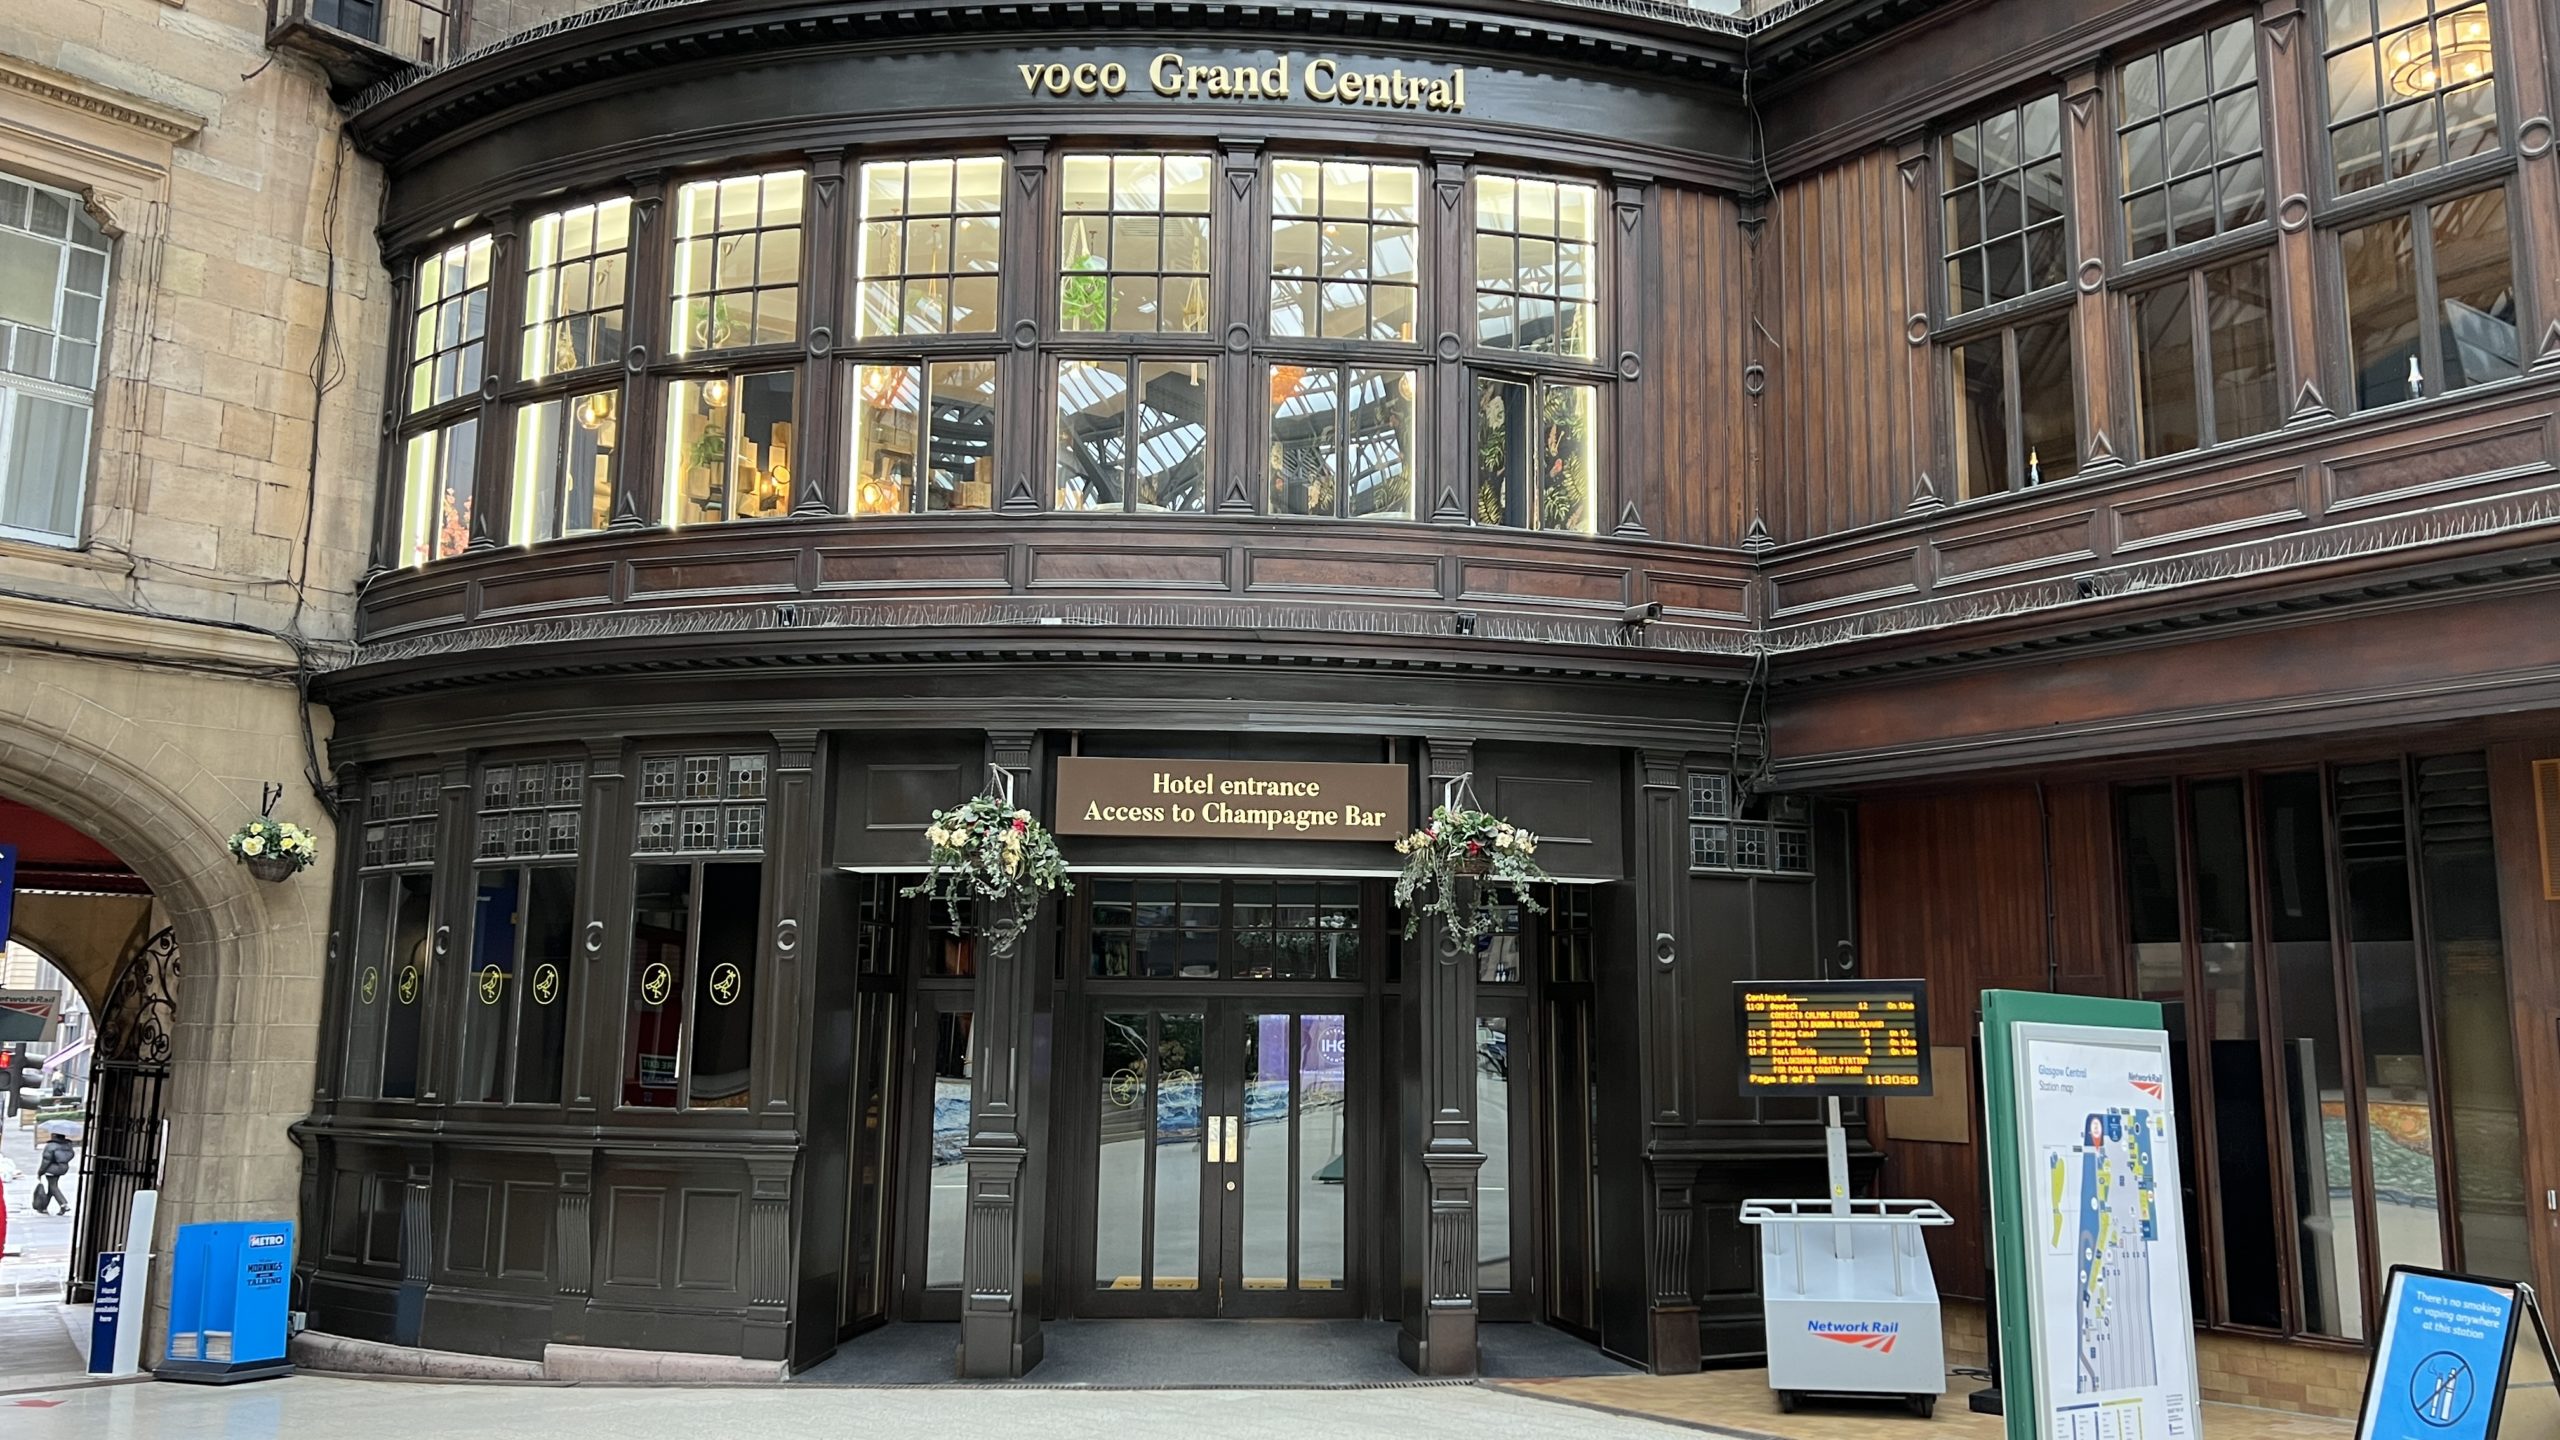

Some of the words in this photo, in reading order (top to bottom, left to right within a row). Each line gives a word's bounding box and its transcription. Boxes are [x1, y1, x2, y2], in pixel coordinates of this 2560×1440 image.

[1018, 61, 1127, 94] voco
[1148, 53, 1290, 99] Grand
[1303, 59, 1466, 111] Central
[1152, 773, 1214, 796] Hotel
[1220, 776, 1320, 797] entrance
[1083, 800, 1165, 822] Access
[1172, 804, 1195, 823] to
[1202, 802, 1338, 831] Champagne
[1345, 805, 1387, 827] Bar
[1799, 1020, 1809, 1028] TO
[1772, 1048, 1789, 1056] East
[2038, 1065, 2064, 1078] Glasgow
[2066, 1067, 2087, 1078] Central
[2128, 1072, 2152, 1081] Network
[2152, 1074, 2163, 1082] Rail
[1749, 1075, 1776, 1084] Page
[1791, 1075, 1804, 1083] of
[2039, 1080, 2059, 1091] Station
[2061, 1083, 2074, 1095] map
[250, 1235, 284, 1247] METRO
[2417, 1291, 2448, 1306] There's
[2449, 1298, 2461, 1307] no
[2463, 1301, 2501, 1316] smoking
[2413, 1305, 2423, 1314] or
[2424, 1308, 2455, 1323] vaping
[2456, 1313, 2500, 1327] anywhere
[1807, 1320, 1869, 1332] Network
[1872, 1321, 1899, 1332] Rail
[2422, 1321, 2433, 1331] at
[2434, 1322, 2451, 1334] this
[2452, 1325, 2485, 1339] station
